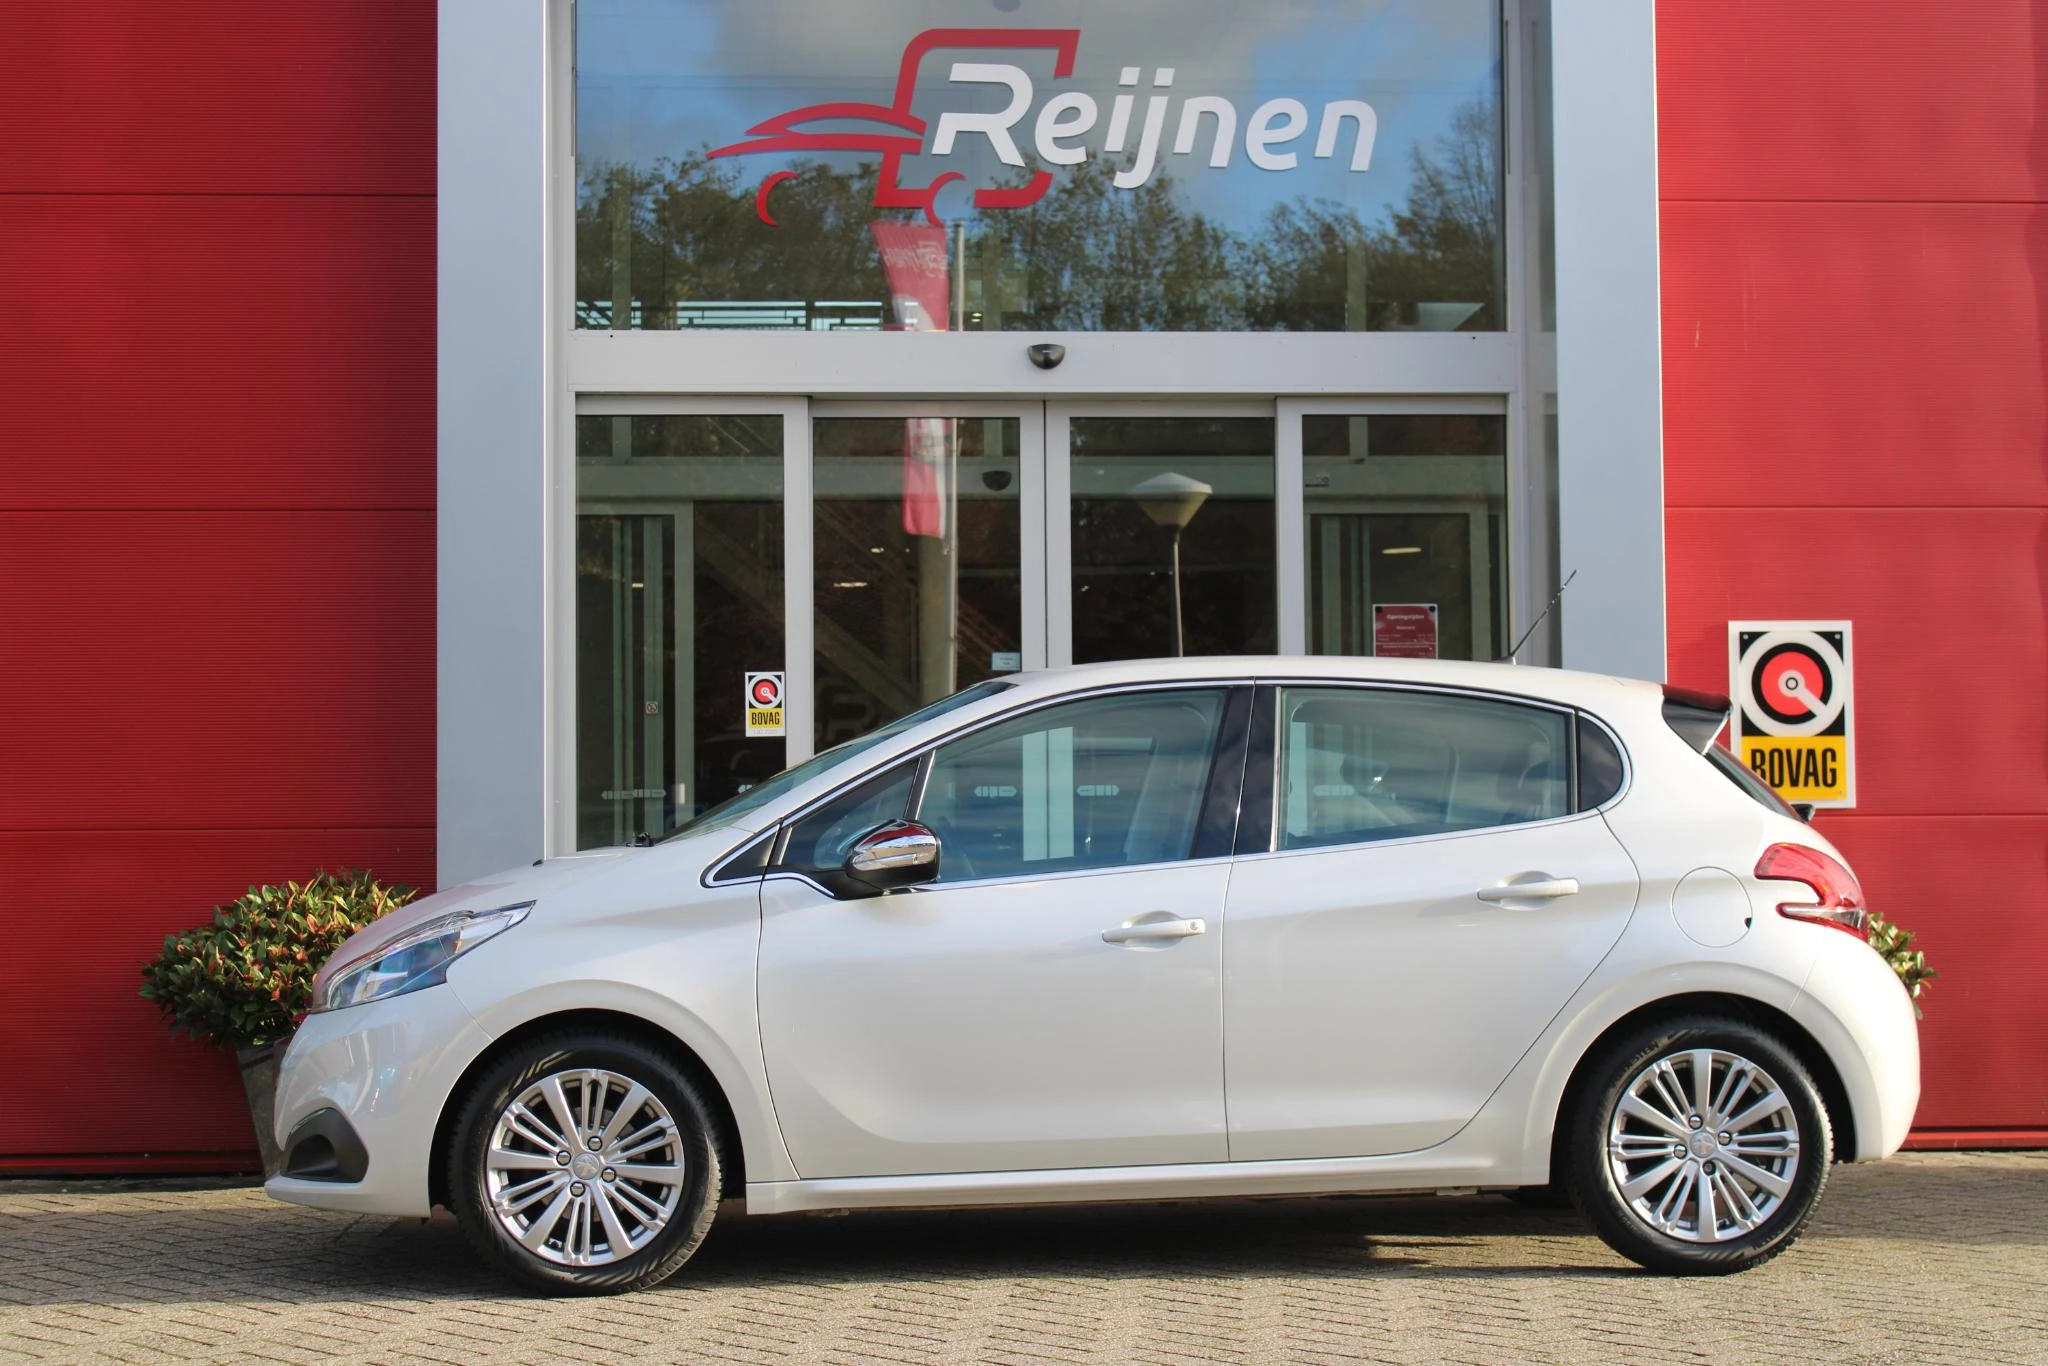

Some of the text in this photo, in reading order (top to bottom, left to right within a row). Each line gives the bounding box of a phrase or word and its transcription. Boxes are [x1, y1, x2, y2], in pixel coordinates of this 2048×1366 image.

[931, 63, 1378, 189] Reijnen
[751, 711, 780, 725] BOVAG
[1751, 748, 1837, 788] BOVAG
